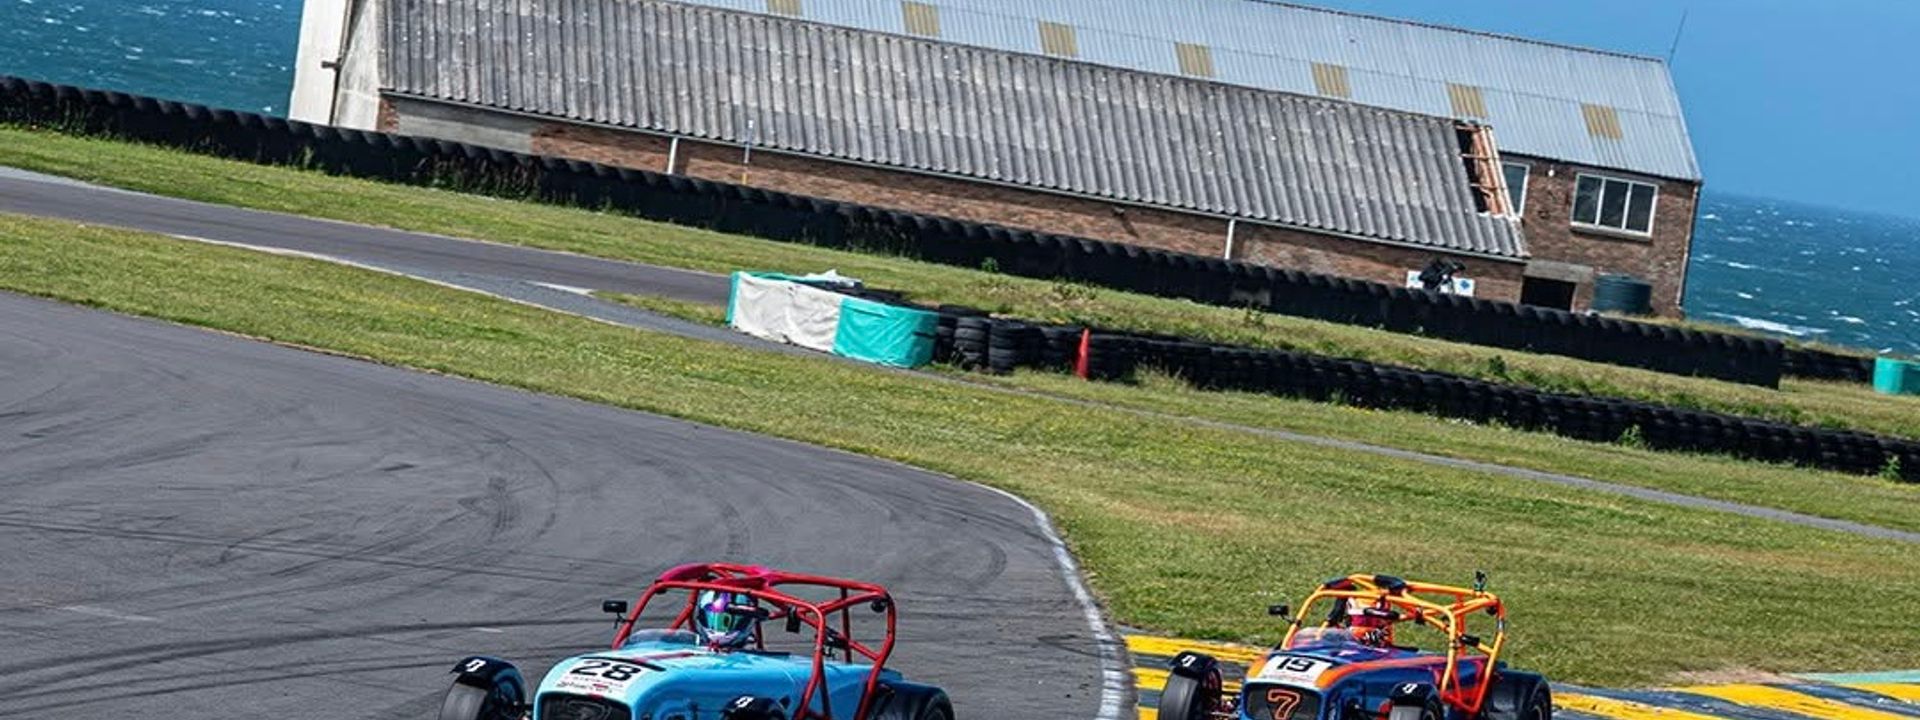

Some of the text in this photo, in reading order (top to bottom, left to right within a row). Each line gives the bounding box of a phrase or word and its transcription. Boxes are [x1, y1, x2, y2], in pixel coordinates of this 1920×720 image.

[570, 660, 642, 682] 28
[1276, 656, 1317, 673] 19
[1267, 688, 1301, 720] 7
